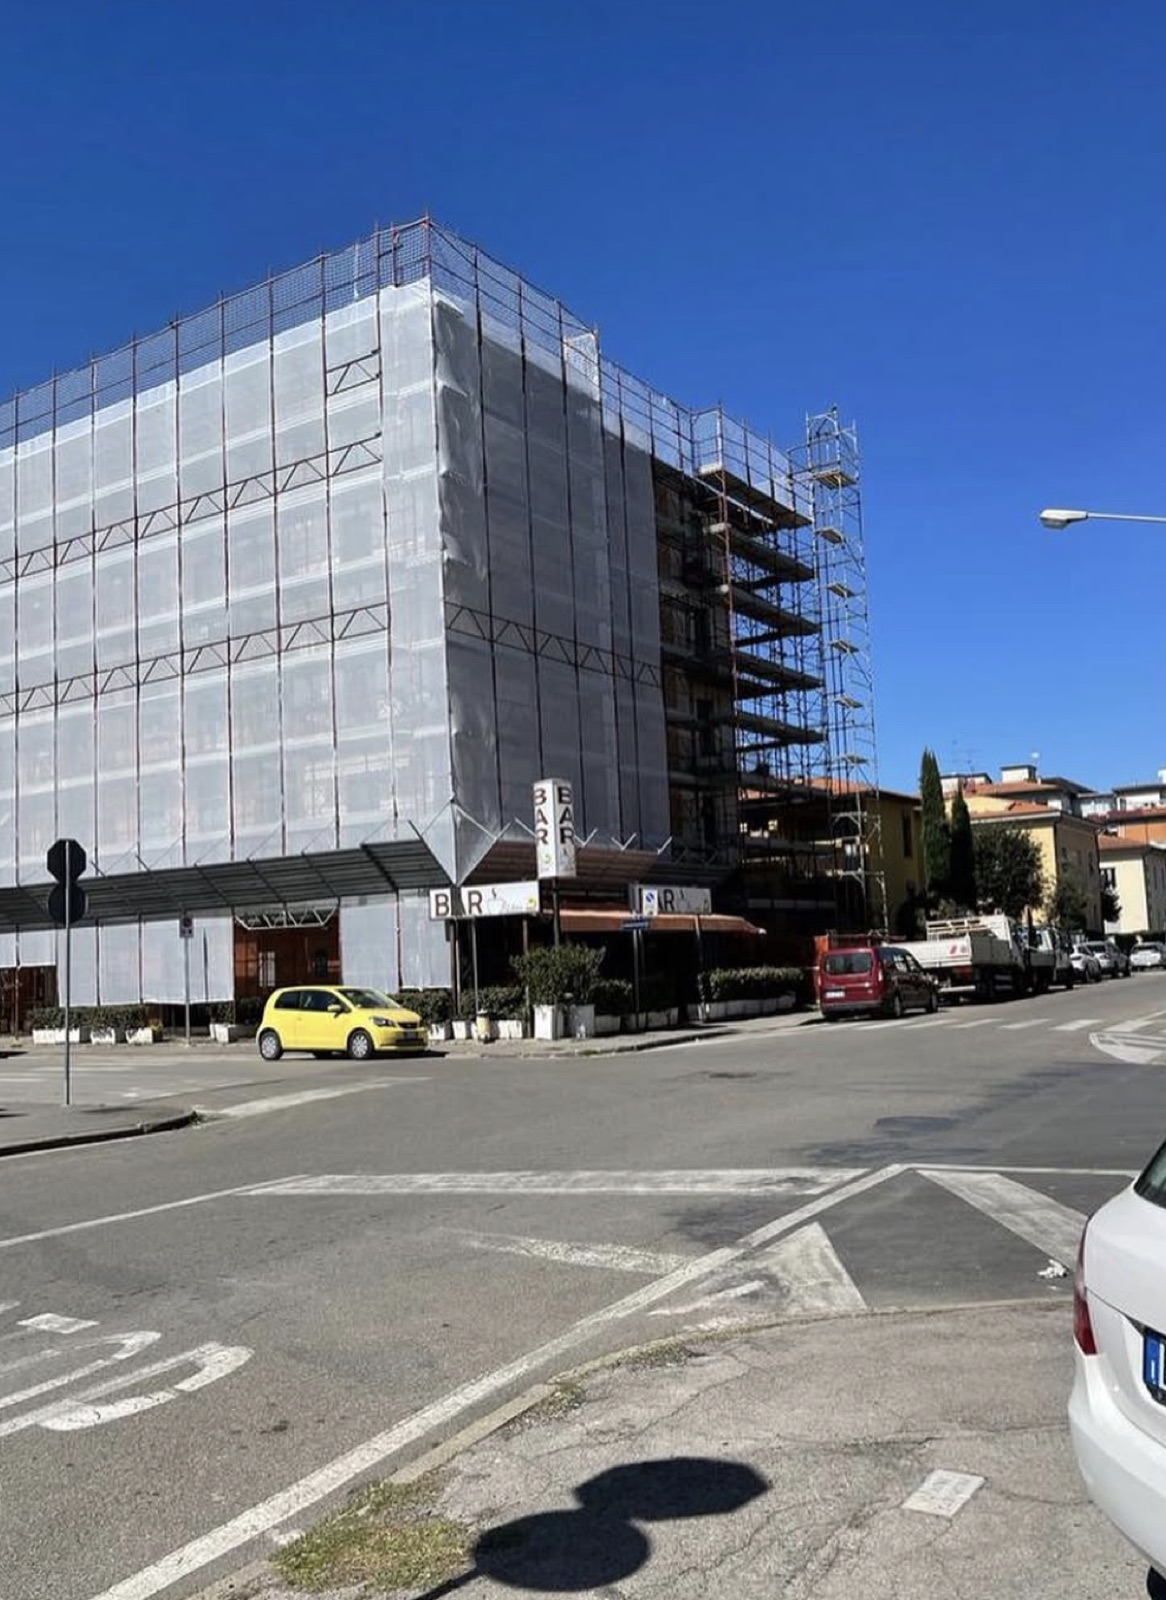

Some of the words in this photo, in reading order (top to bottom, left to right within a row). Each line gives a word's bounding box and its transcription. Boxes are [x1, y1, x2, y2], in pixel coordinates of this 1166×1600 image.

[534, 787, 549, 845] BAR
[557, 786, 575, 845] BAR
[434, 890, 483, 917] BR
